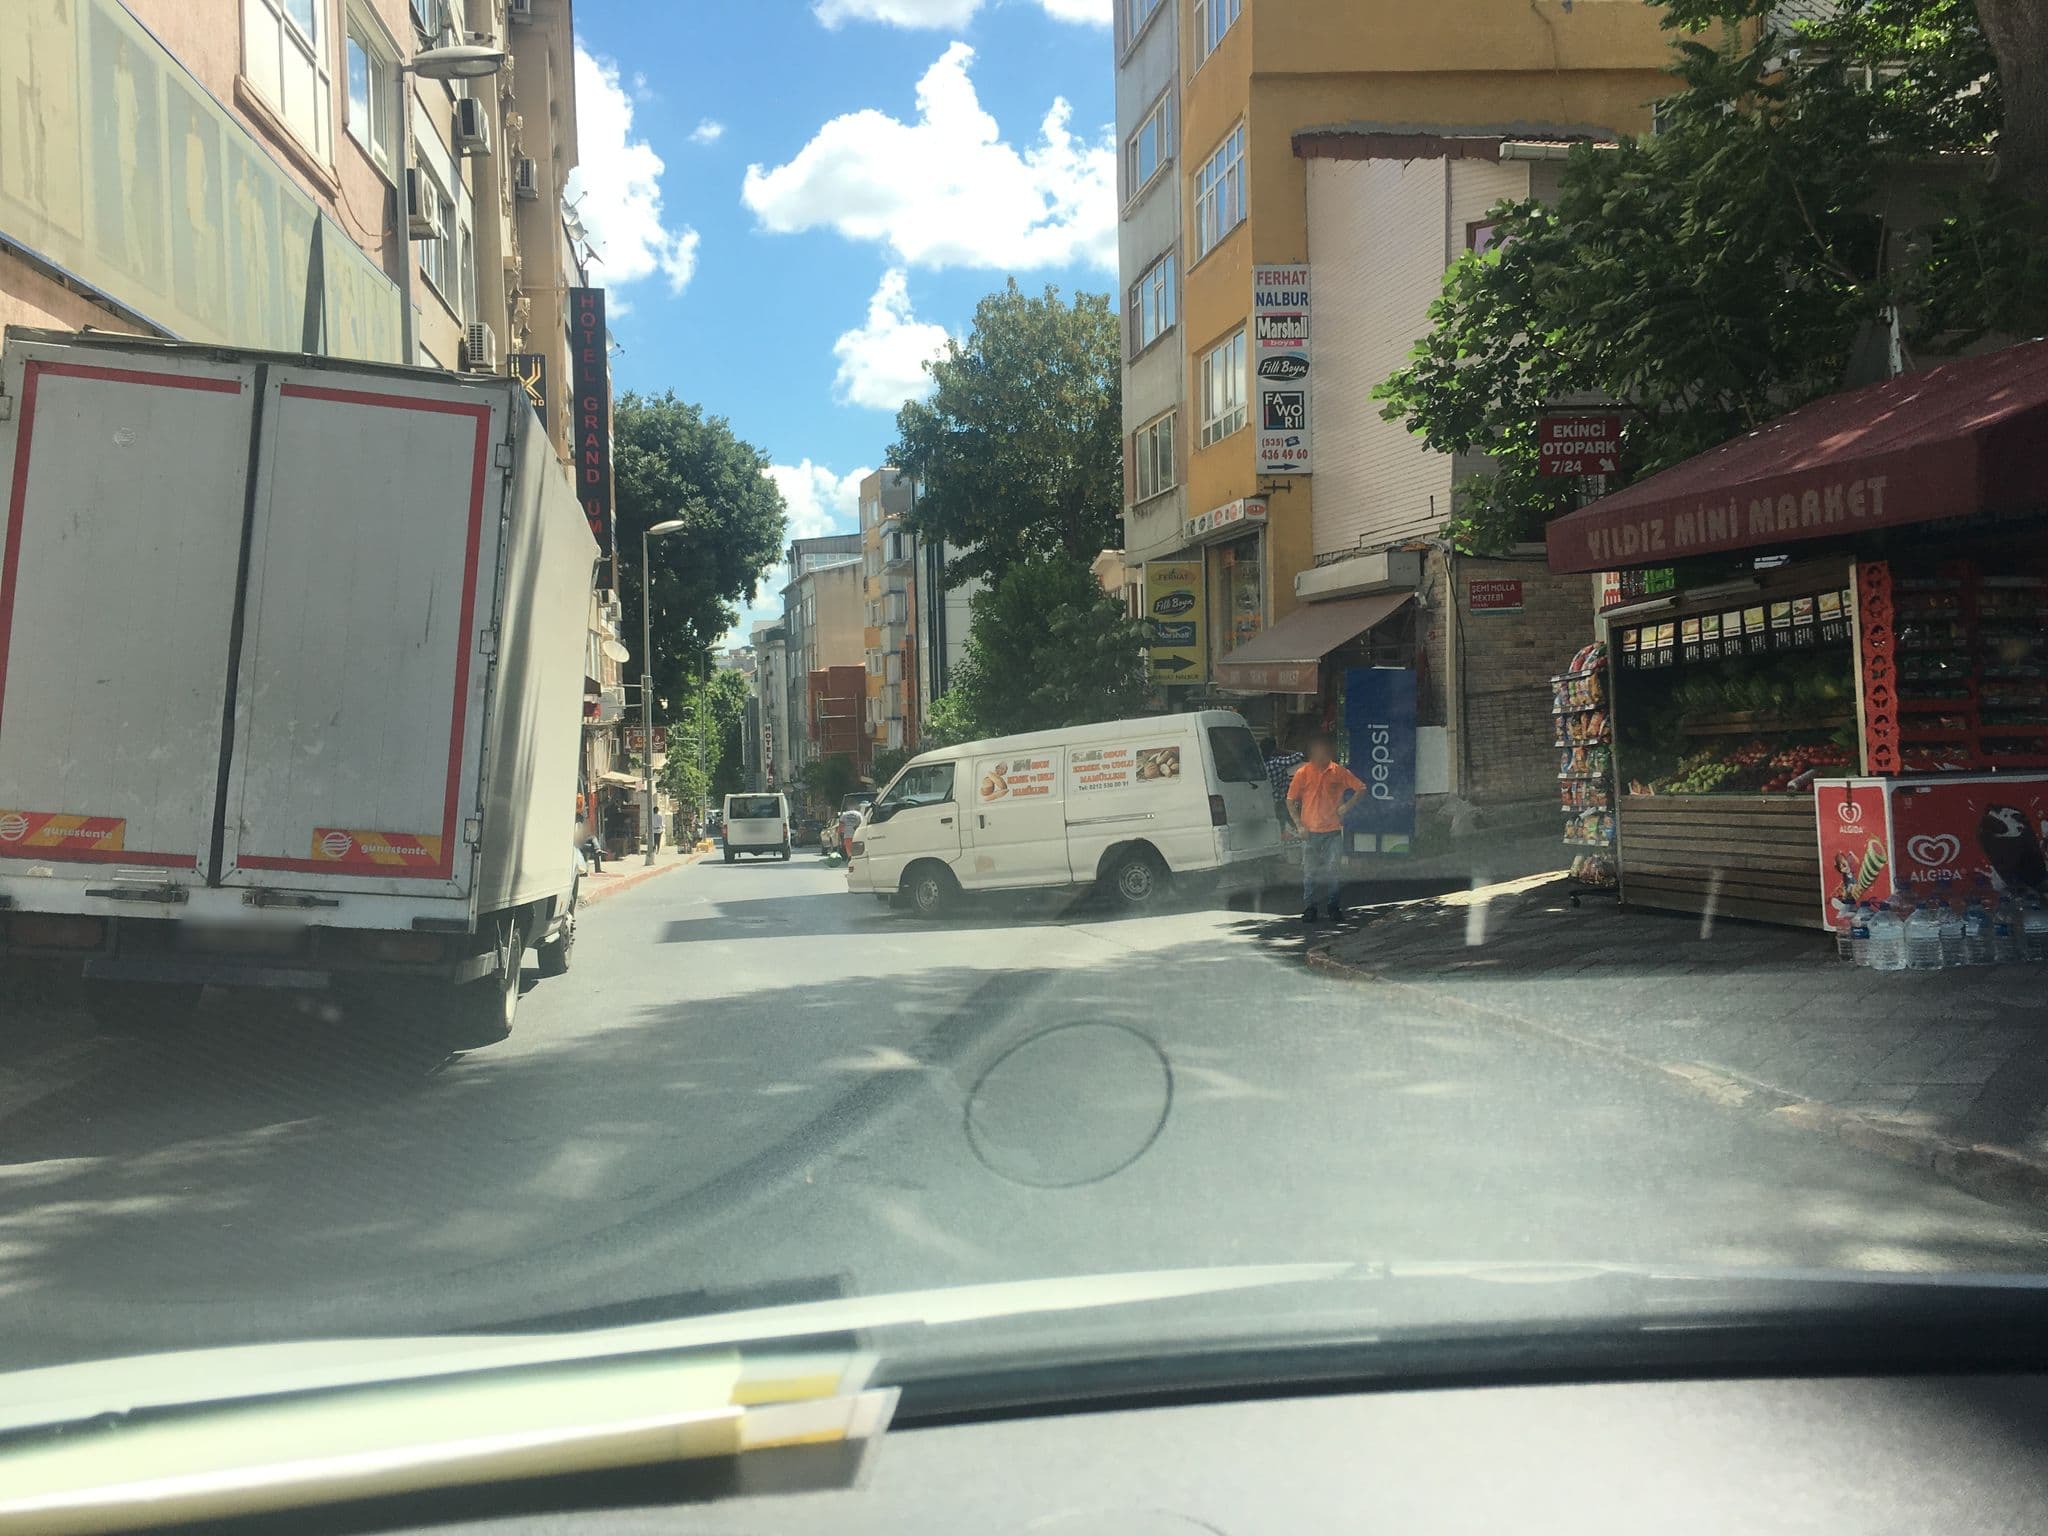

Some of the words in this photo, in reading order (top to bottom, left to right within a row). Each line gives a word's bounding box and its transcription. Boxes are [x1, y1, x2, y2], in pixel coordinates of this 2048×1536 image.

[1257, 270, 1307, 286] FERHAT
[1255, 291, 1309, 307] NALBUR
[1257, 316, 1308, 339] Marshall
[579, 294, 597, 382] HOTEL
[1281, 360, 1307, 377] Boya
[583, 396, 601, 483] GRAND
[1261, 437, 1284, 448] (535)
[1542, 440, 1617, 455] OTOPARK
[1261, 449, 1279, 460] 436
[1281, 448, 1294, 460] 49
[1296, 448, 1308, 460] 60
[1551, 460, 1583, 473] 7/24
[1748, 475, 1888, 536] MARKET
[1368, 724, 1394, 800] pepsi
